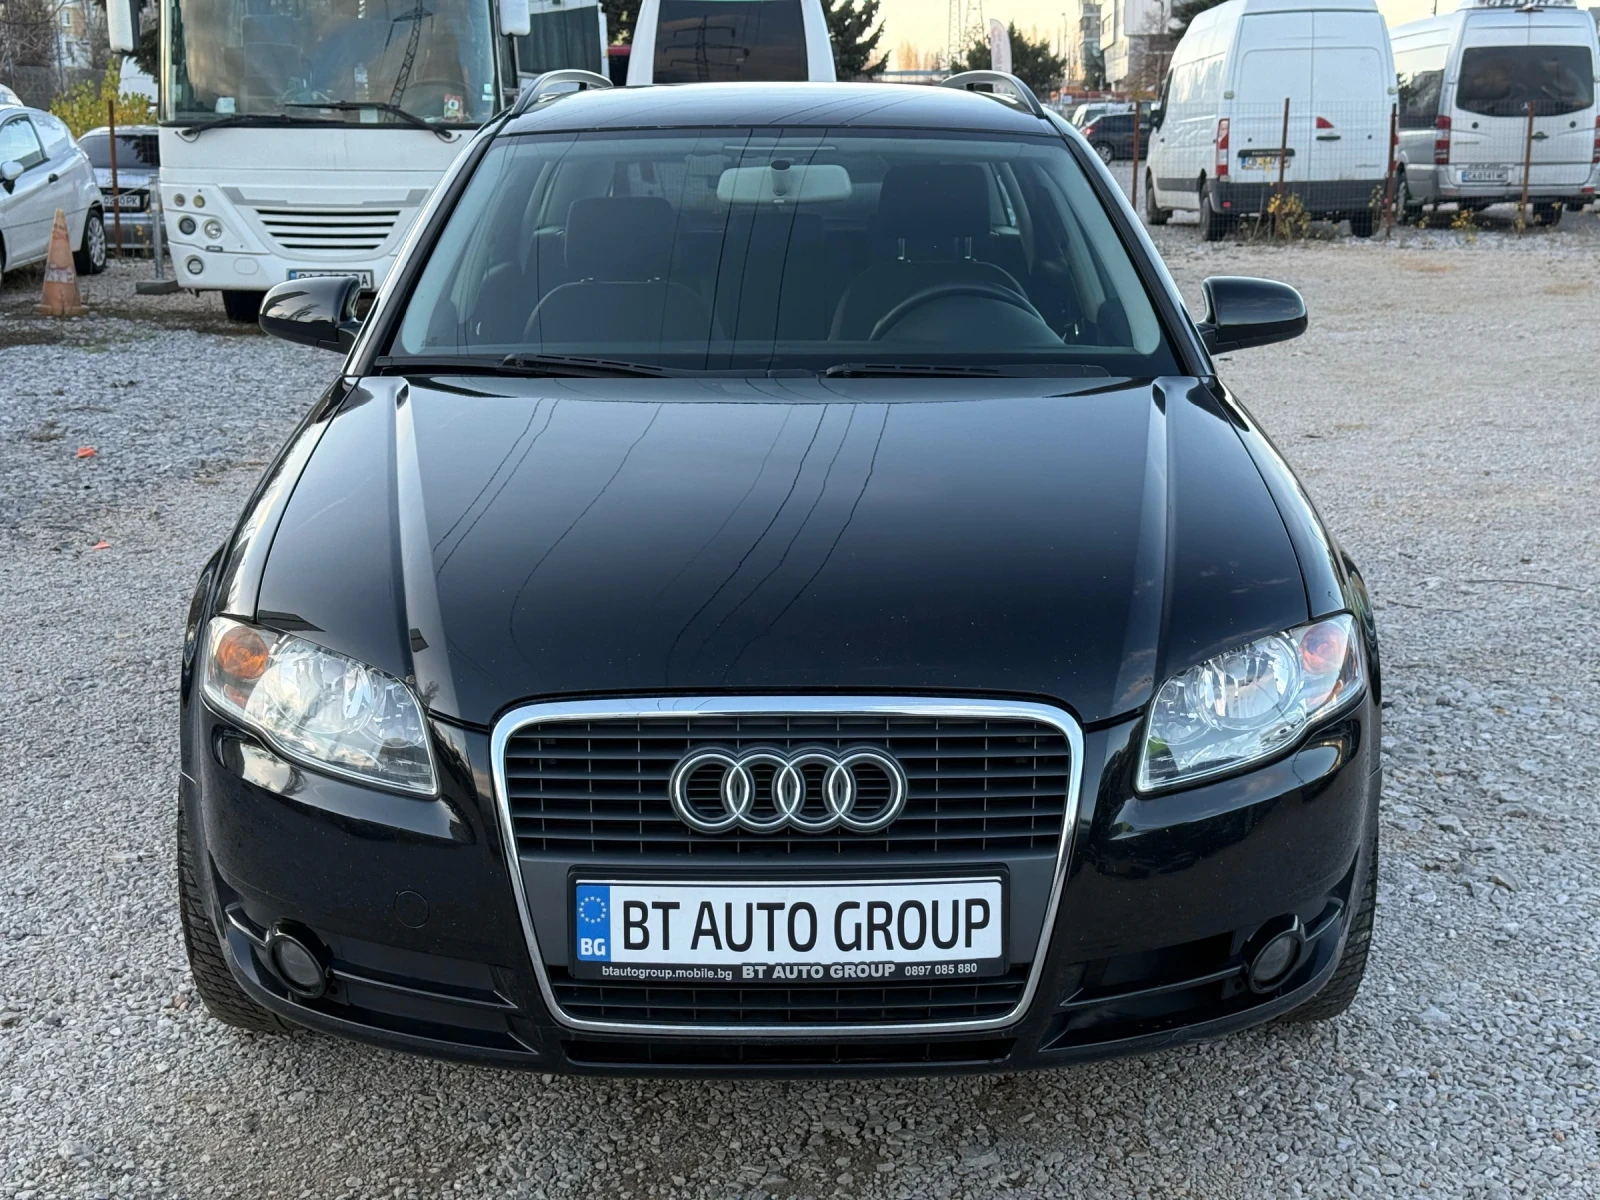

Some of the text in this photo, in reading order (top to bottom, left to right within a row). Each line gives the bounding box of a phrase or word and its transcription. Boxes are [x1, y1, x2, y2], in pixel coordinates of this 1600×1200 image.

[623, 897, 990, 953] BT AUTO GROUP
[580, 937, 606, 956] BG
[602, 962, 978, 980] btautogroup.mobile.bg BT AUTO GROUP 0897 085 880
